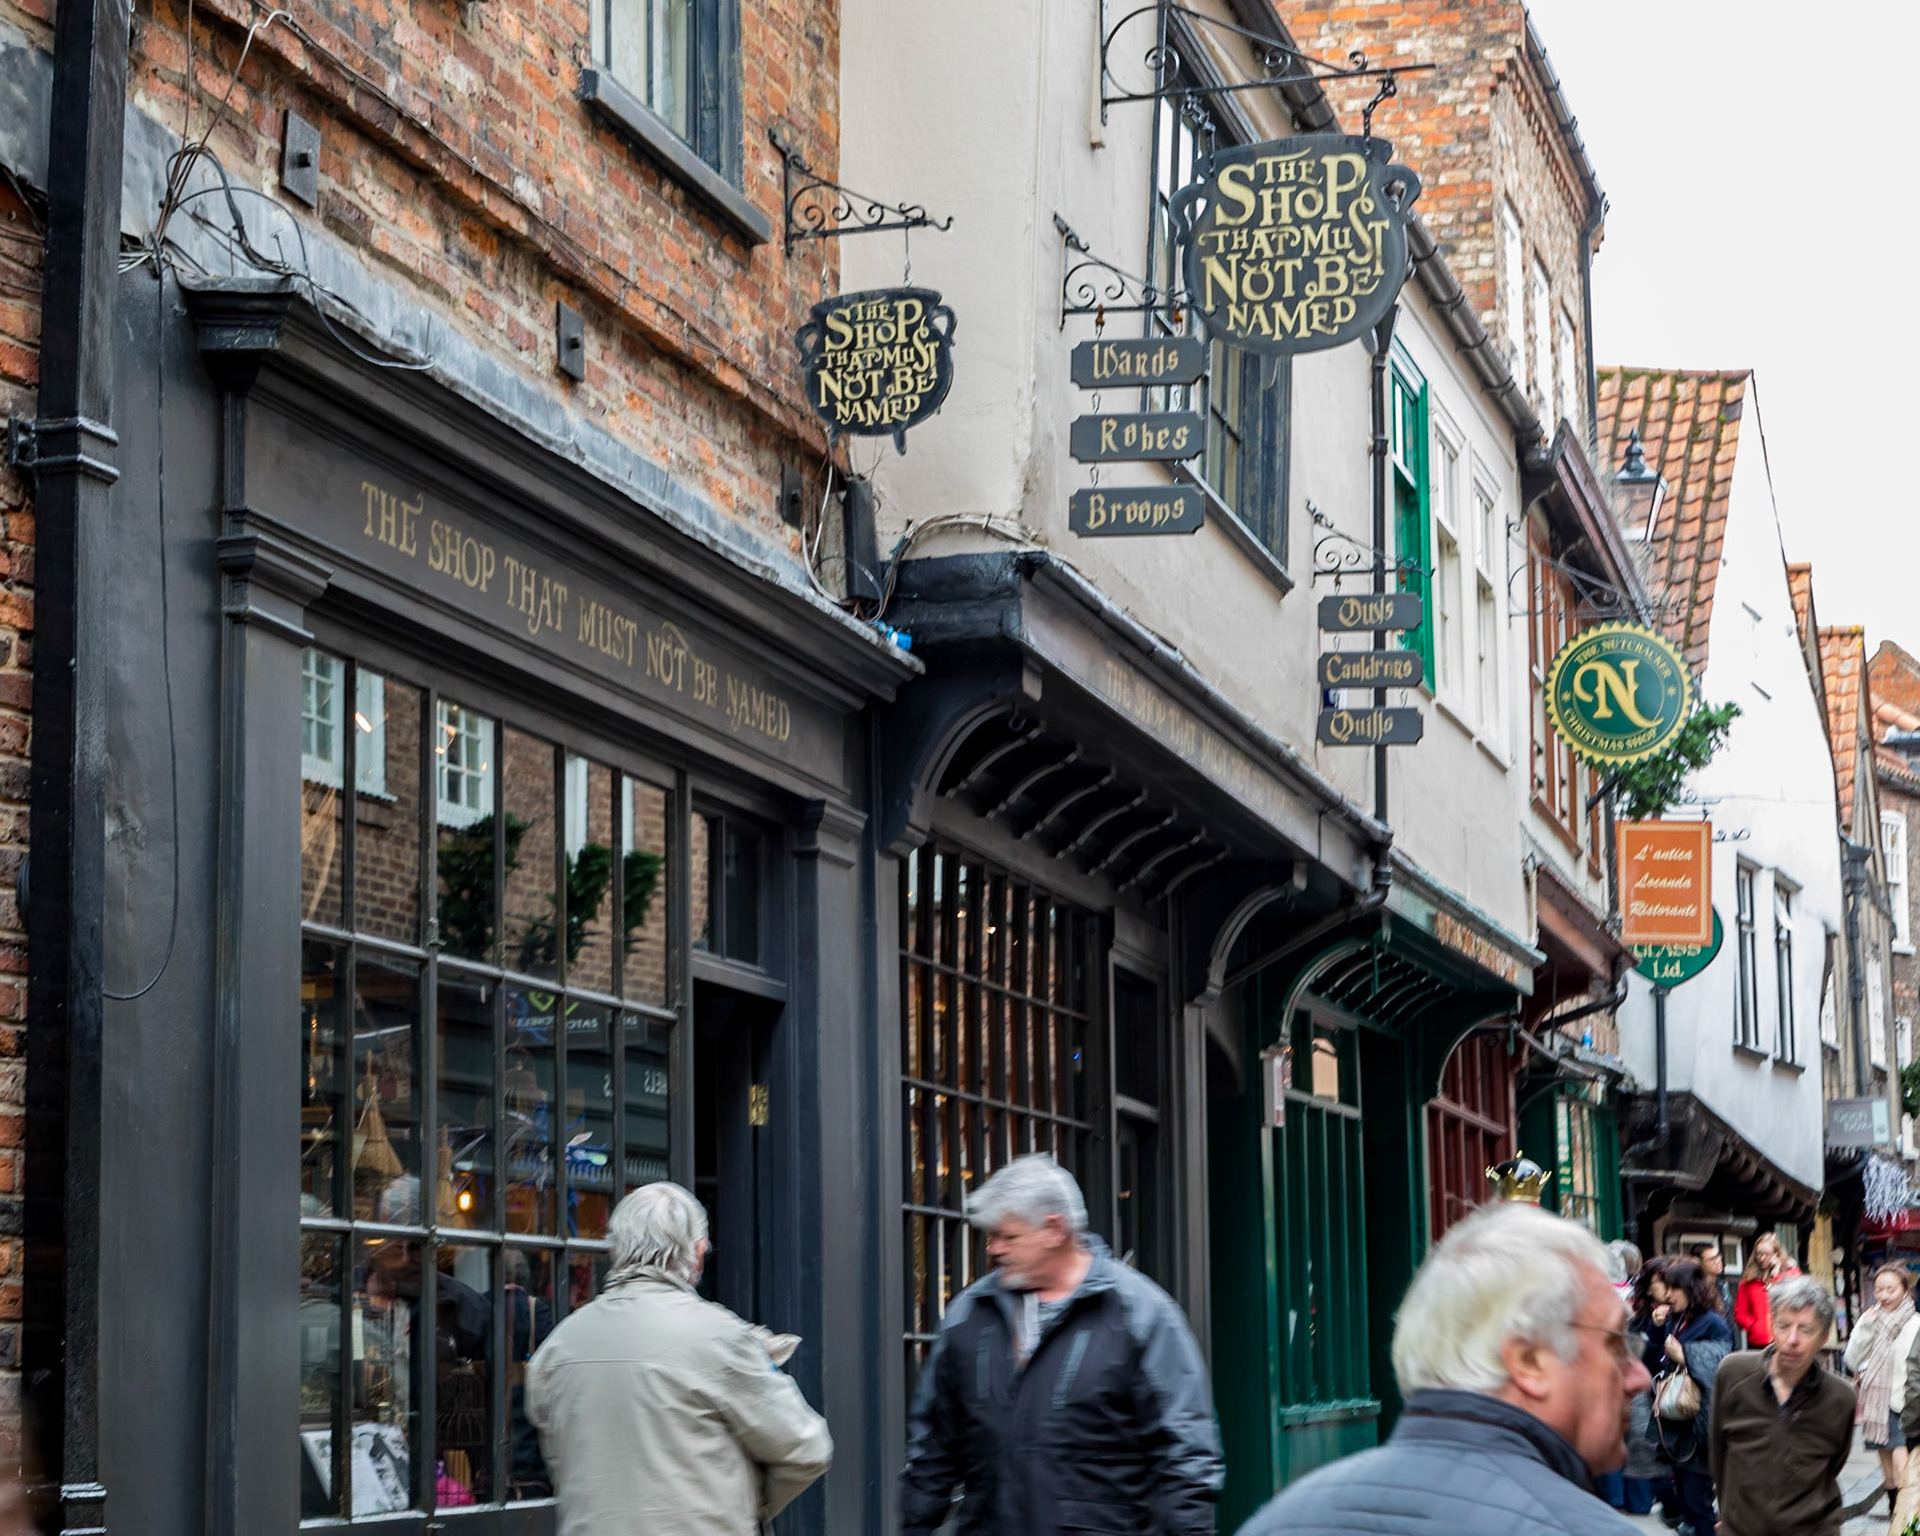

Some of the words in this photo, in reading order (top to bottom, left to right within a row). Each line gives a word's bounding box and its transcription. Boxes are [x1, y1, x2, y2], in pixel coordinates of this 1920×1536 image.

[1256, 147, 1323, 184] THE
[1215, 153, 1367, 226] SHOP
[1198, 227, 1301, 261] THAT
[1302, 180, 1390, 276] MUST
[1201, 252, 1303, 313] NOT
[1304, 255, 1379, 304] BE
[825, 299, 923, 350] SHOP
[851, 296, 895, 321] THE
[1227, 296, 1356, 341] NAMED
[815, 347, 882, 371] THAT
[883, 315, 939, 380] MUST
[1092, 342, 1179, 379] Wands
[817, 368, 884, 407] NOT
[886, 367, 935, 398] BE
[836, 394, 920, 426] NAMED
[1101, 418, 1190, 455] Robes
[1085, 493, 1185, 530] Brooms
[361, 481, 424, 557] THE
[428, 519, 496, 593] SHOP
[504, 555, 568, 634] THAT
[578, 597, 637, 667] MUST
[645, 621, 690, 692] NOT
[692, 657, 718, 708] BE
[726, 674, 791, 742] NAMED
[1338, 597, 1394, 627] Owls
[1326, 654, 1413, 683] Cauldrons
[1573, 659, 1665, 729] N
[1330, 710, 1394, 744] Quills
[1634, 871, 1692, 889] Locanda
[1629, 901, 1698, 917] Ristorante
